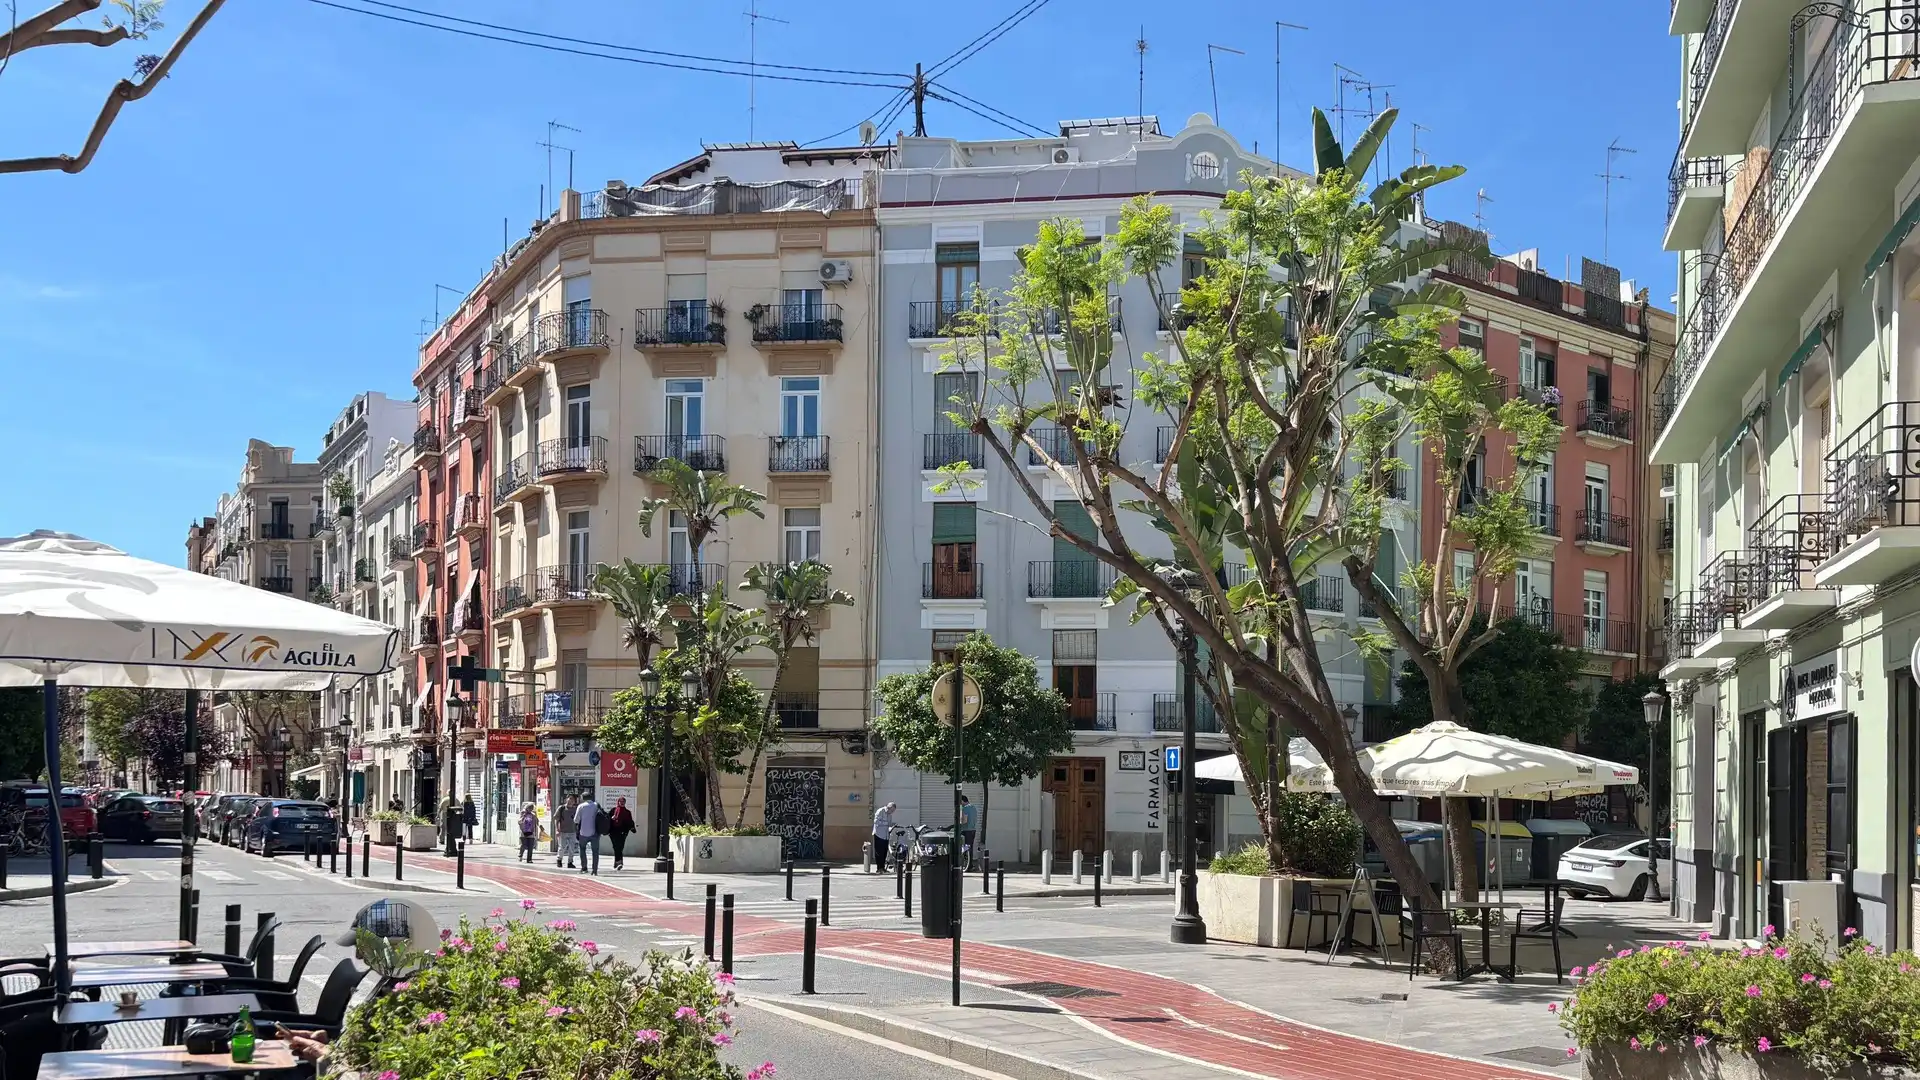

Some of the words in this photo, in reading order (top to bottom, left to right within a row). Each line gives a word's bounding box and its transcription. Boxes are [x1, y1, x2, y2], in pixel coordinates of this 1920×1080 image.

[323, 643, 335, 652] EL
[283, 648, 356, 667] ÁGUILA
[1147, 747, 1160, 829] FARMACIA
[1382, 778, 1395, 787] que
[1395, 778, 1420, 786] respires
[1422, 778, 1434, 786] más
